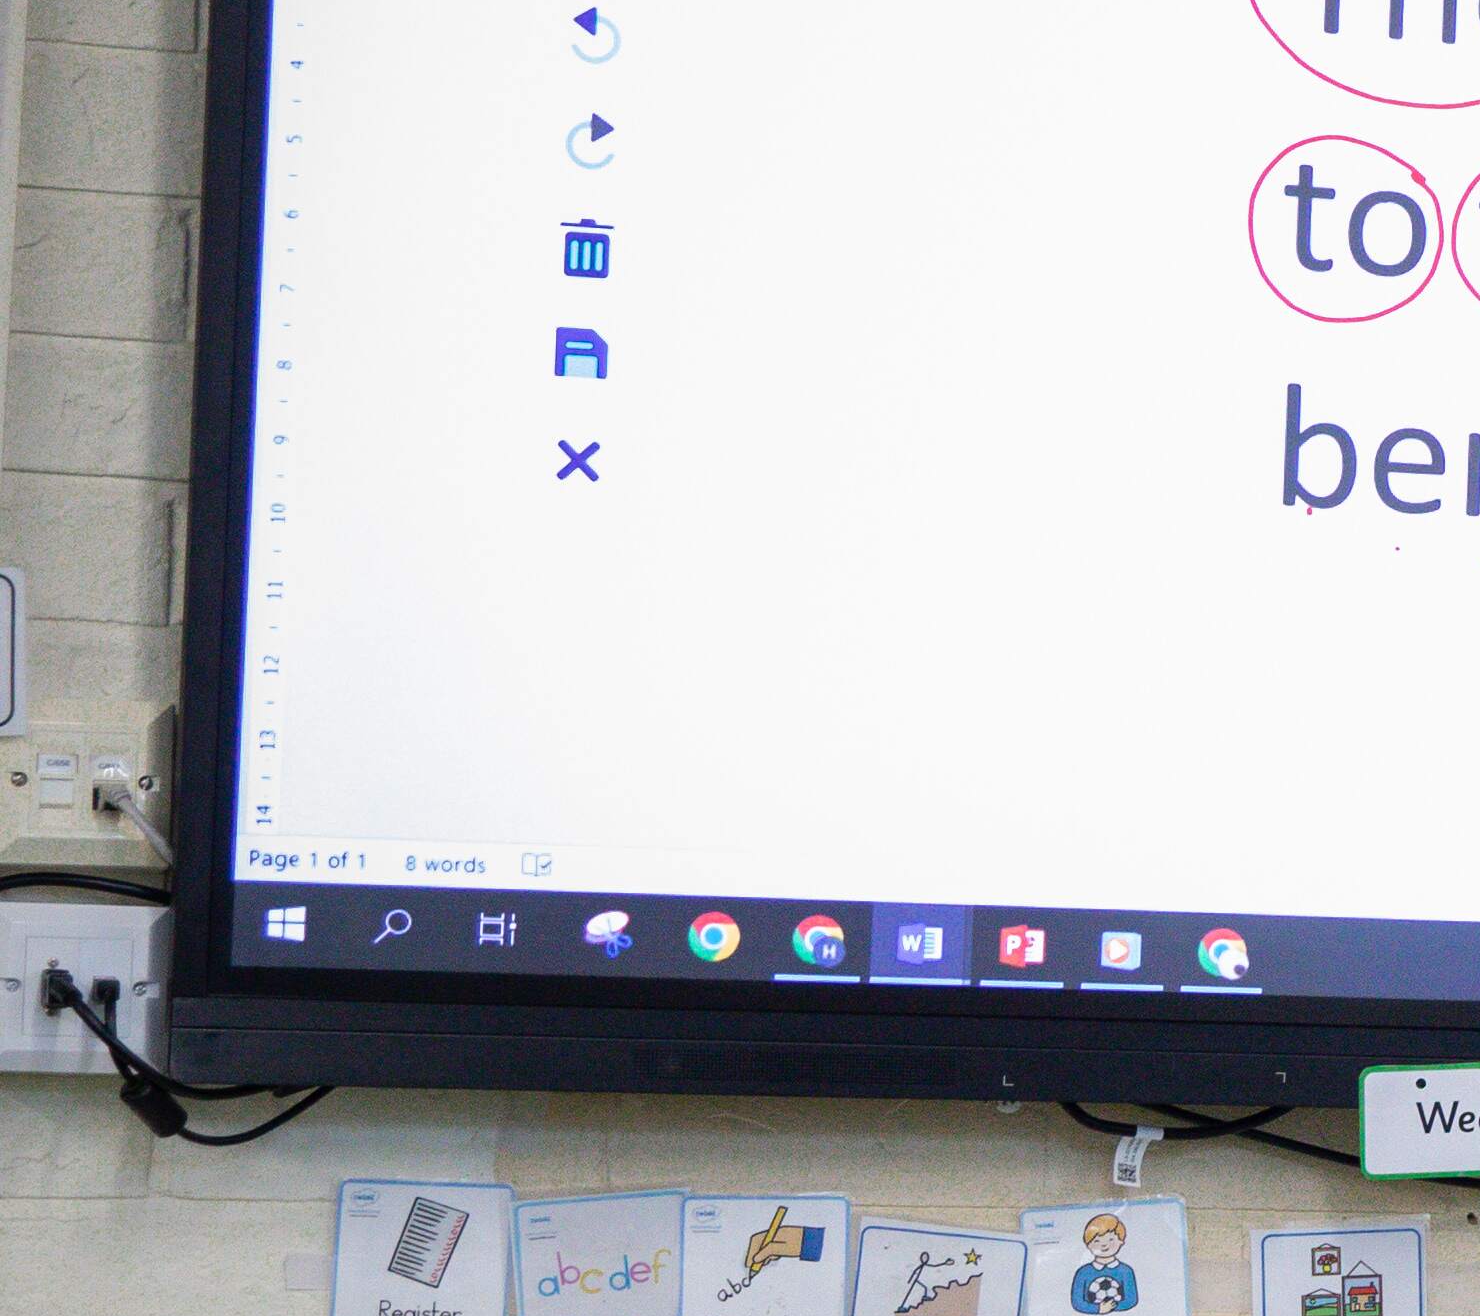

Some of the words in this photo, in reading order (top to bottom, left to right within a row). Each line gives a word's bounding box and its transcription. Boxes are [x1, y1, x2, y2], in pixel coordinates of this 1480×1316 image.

[1285, 164, 1426, 276] to
[249, 849, 299, 872] Page
[310, 852, 318, 867] 1
[327, 851, 349, 869] of
[358, 853, 365, 868] 1
[405, 854, 416, 872] 8
[425, 857, 486, 874] words
